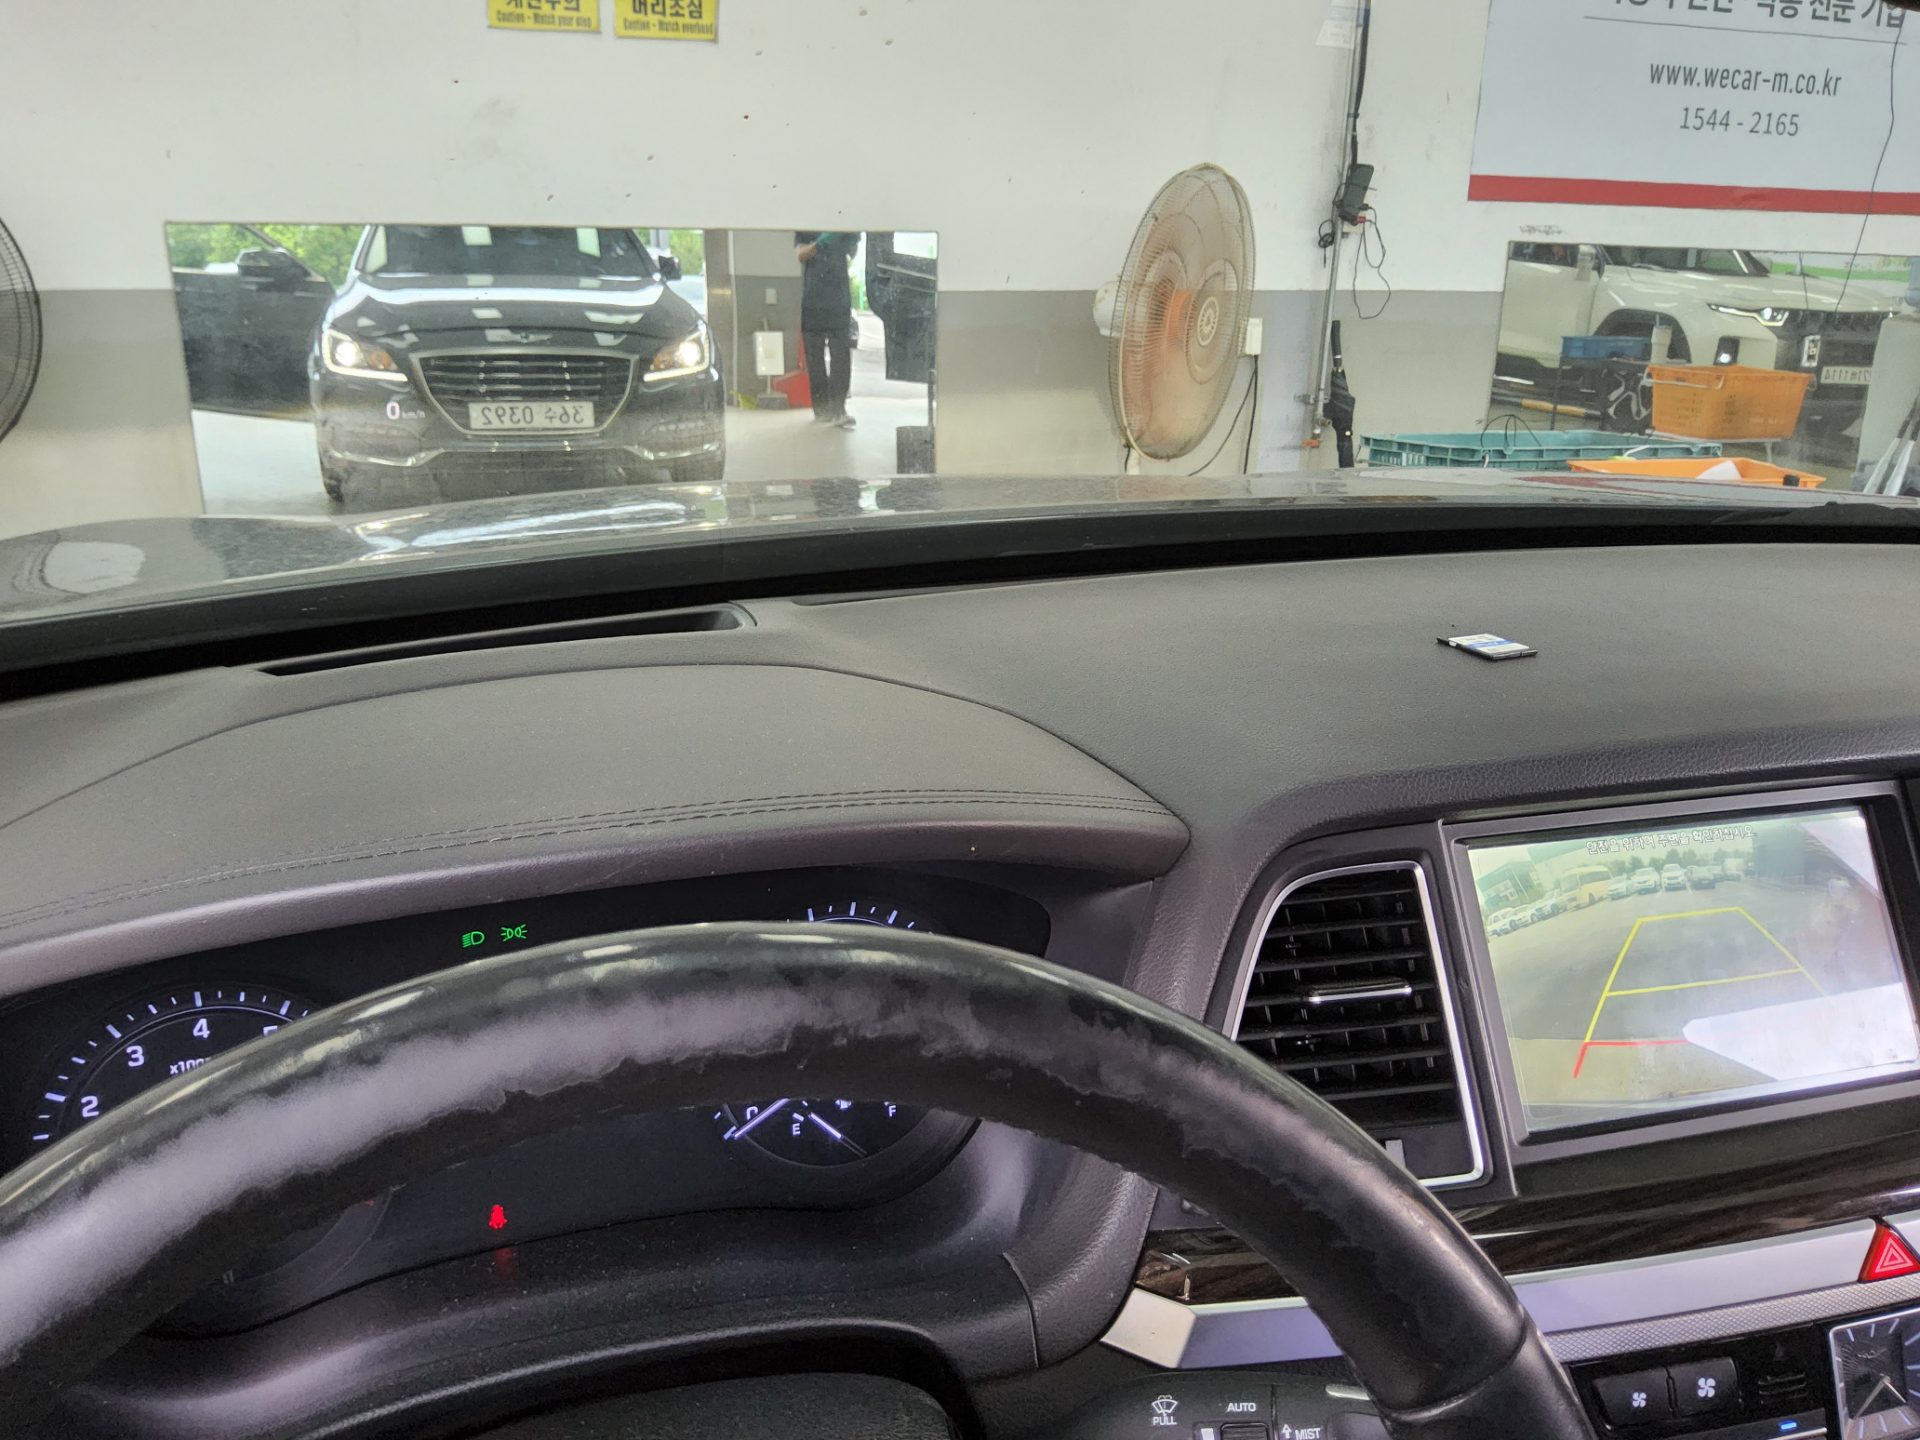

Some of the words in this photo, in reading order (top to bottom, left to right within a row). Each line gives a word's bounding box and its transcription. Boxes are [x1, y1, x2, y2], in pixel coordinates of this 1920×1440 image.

[1650, 63, 1842, 96] www.wecar-m.co.kr
[386, 401, 400, 420] 0
[1586, 838, 1620, 854] 안전을
[1622, 834, 1655, 851] 위하여
[1657, 832, 1689, 847] 주변을
[1692, 825, 1754, 843] 확인하십시오
[192, 1018, 210, 1038] 4
[126, 1045, 145, 1067] 3
[80, 1095, 99, 1118] 2
[888, 1105, 897, 1117] F
[792, 1123, 801, 1136] E
[1227, 1403, 1256, 1412] AUTO
[1152, 1416, 1178, 1426] PULL
[1295, 1428, 1321, 1440] MIST
